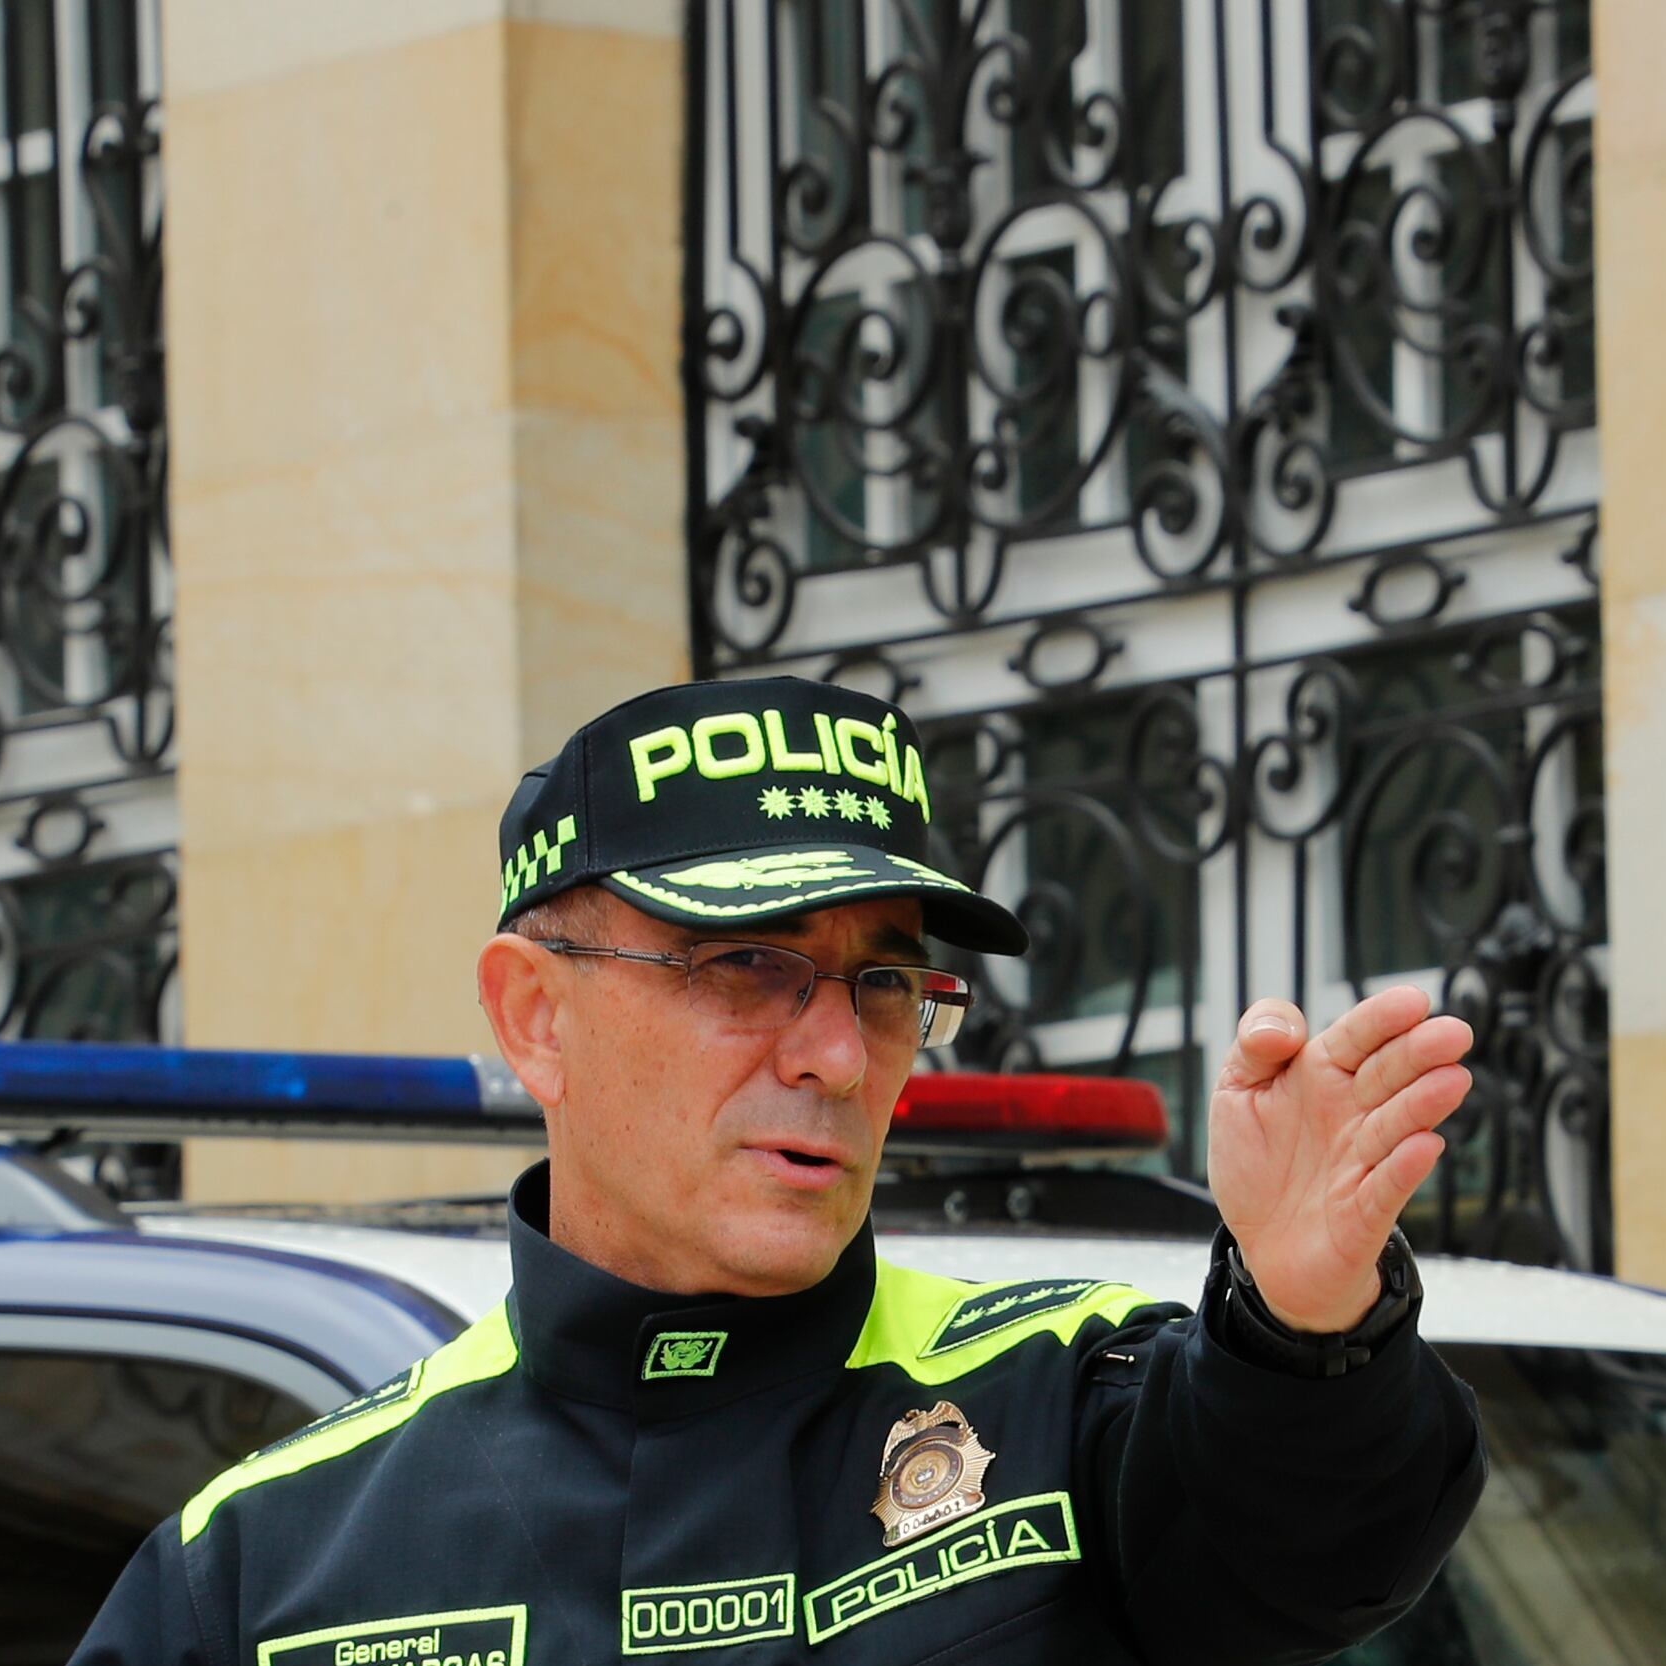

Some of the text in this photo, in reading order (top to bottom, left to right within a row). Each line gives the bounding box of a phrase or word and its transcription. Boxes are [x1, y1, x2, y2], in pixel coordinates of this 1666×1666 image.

[629, 709, 930, 824] POLICÍA
[632, 1588, 786, 1639] 000001
[830, 1519, 1051, 1623] POLICÍA
